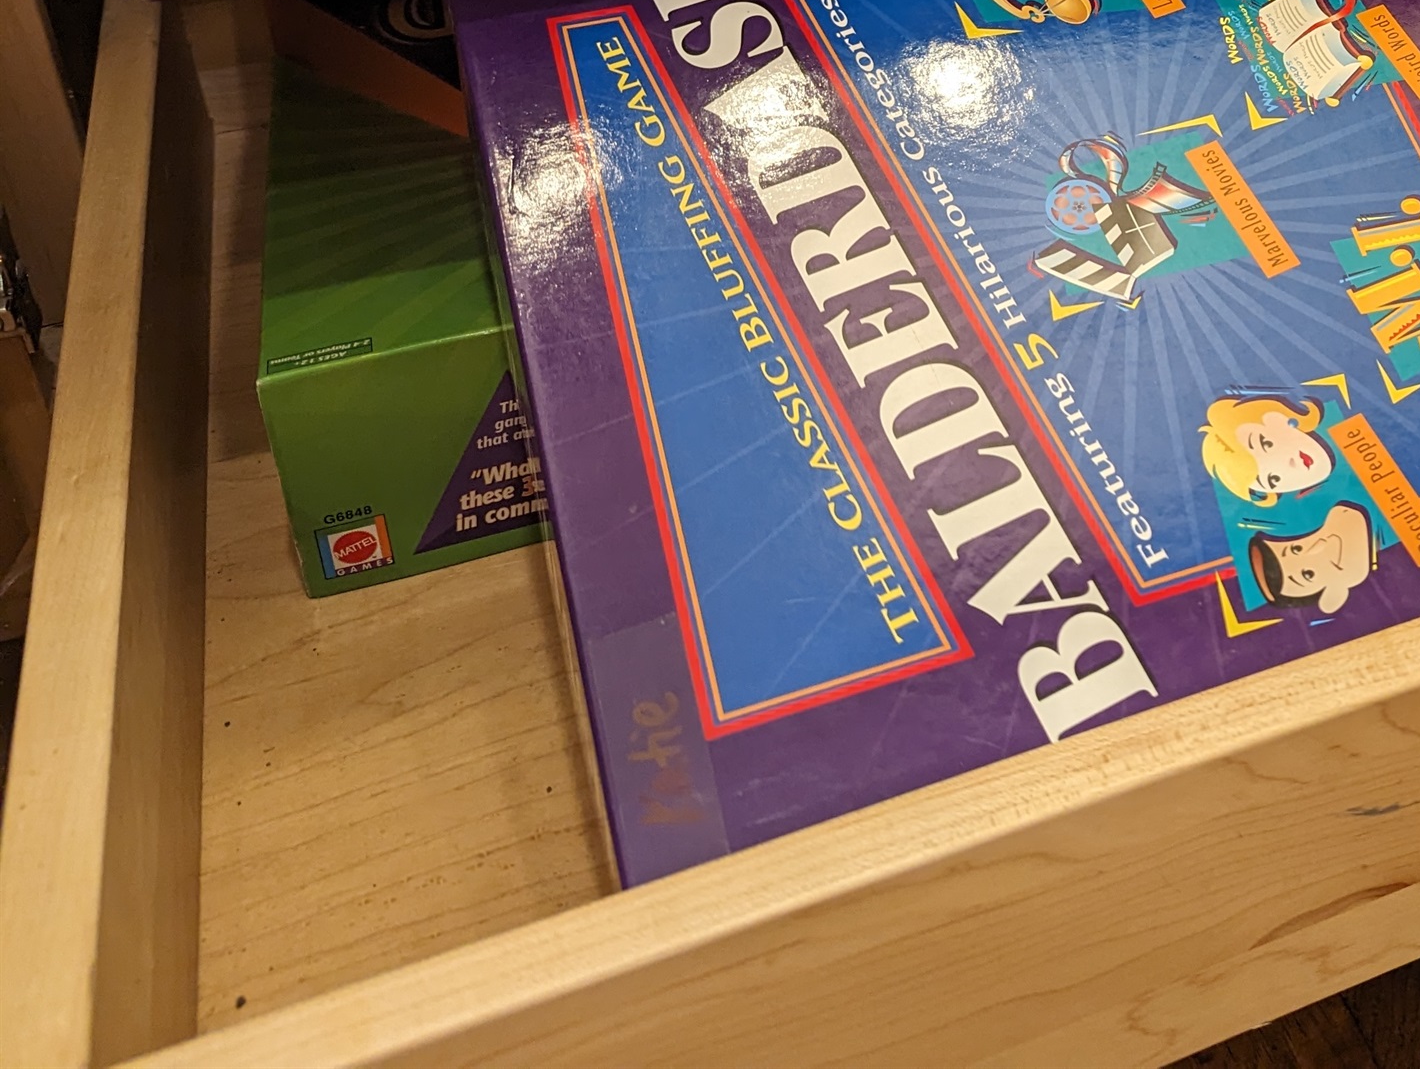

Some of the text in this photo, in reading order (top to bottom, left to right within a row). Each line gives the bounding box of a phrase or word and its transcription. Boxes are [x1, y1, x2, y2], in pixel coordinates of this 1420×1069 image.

[1369, 14, 1410, 52] Words
[1201, 148, 1290, 268] Marvelous Movies
[922, 165, 1028, 330] Hilarious
[316, 343, 351, 355] Players
[596, 36, 920, 645] THE CLASSIC BLUFFING GAME
[1013, 333, 1060, 372] 5
[318, 350, 348, 363] AGES
[477, 432, 509, 450] that
[1343, 428, 1396, 483] People
[1044, 372, 1170, 569] Featuring
[460, 485, 515, 511] these
[323, 504, 373, 526] G6848
[456, 513, 478, 532] in
[334, 535, 377, 559] MATTEL
[336, 556, 394, 577] GAMES
